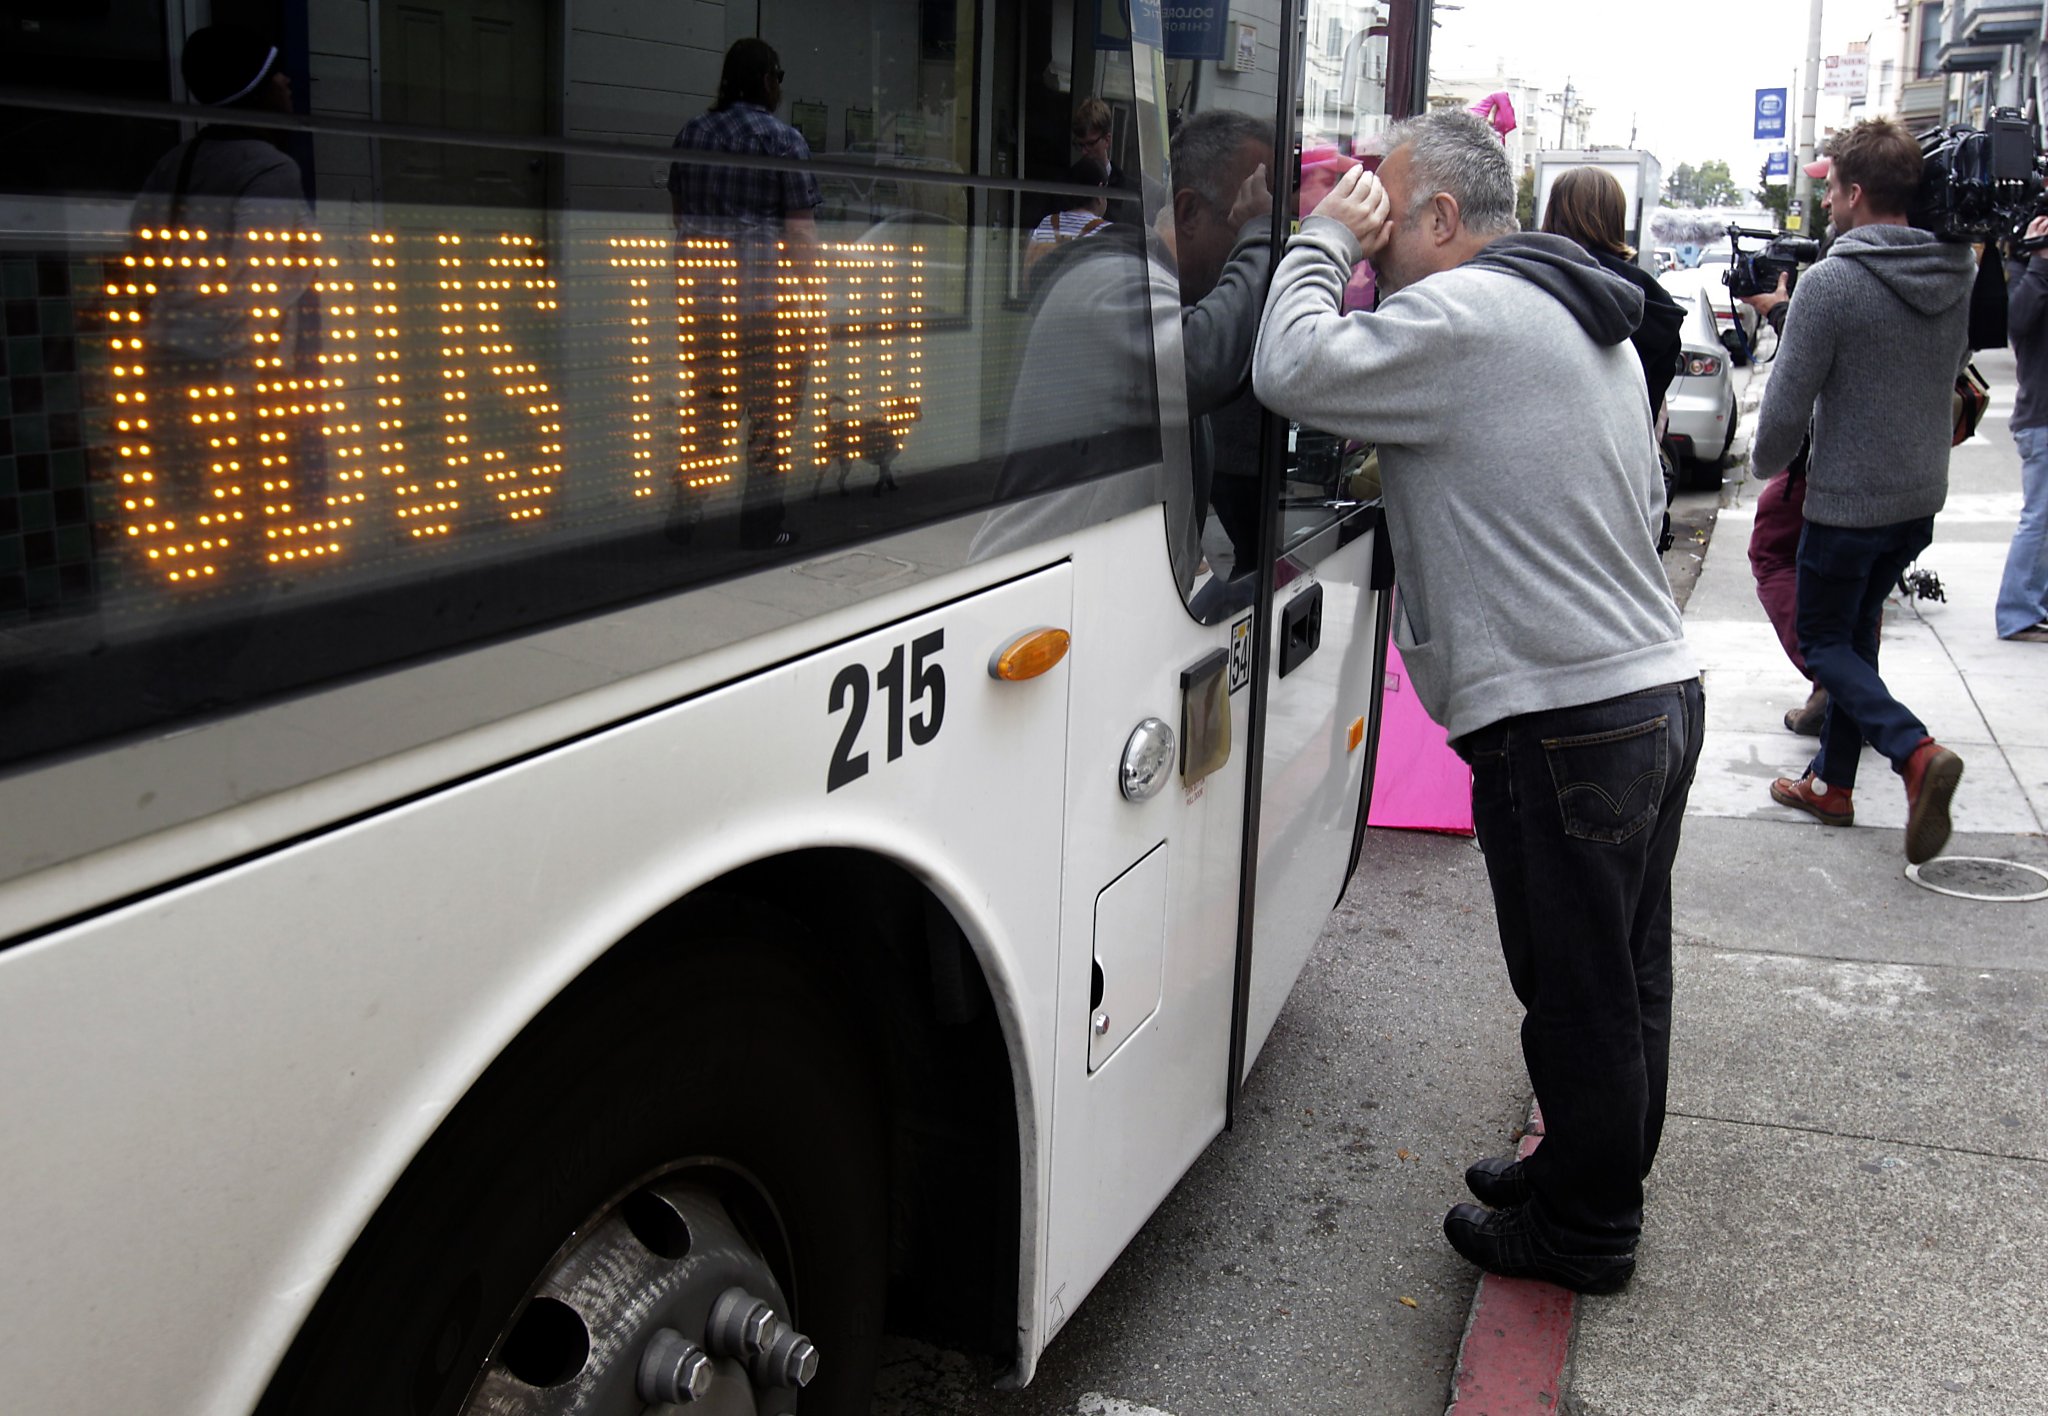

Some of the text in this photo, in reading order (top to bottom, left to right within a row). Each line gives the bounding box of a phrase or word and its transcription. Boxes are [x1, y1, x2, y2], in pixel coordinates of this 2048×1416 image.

[105, 228, 924, 582] GBUS TO MTV
[827, 628, 945, 793] 215
[1231, 634, 1248, 686] 54
